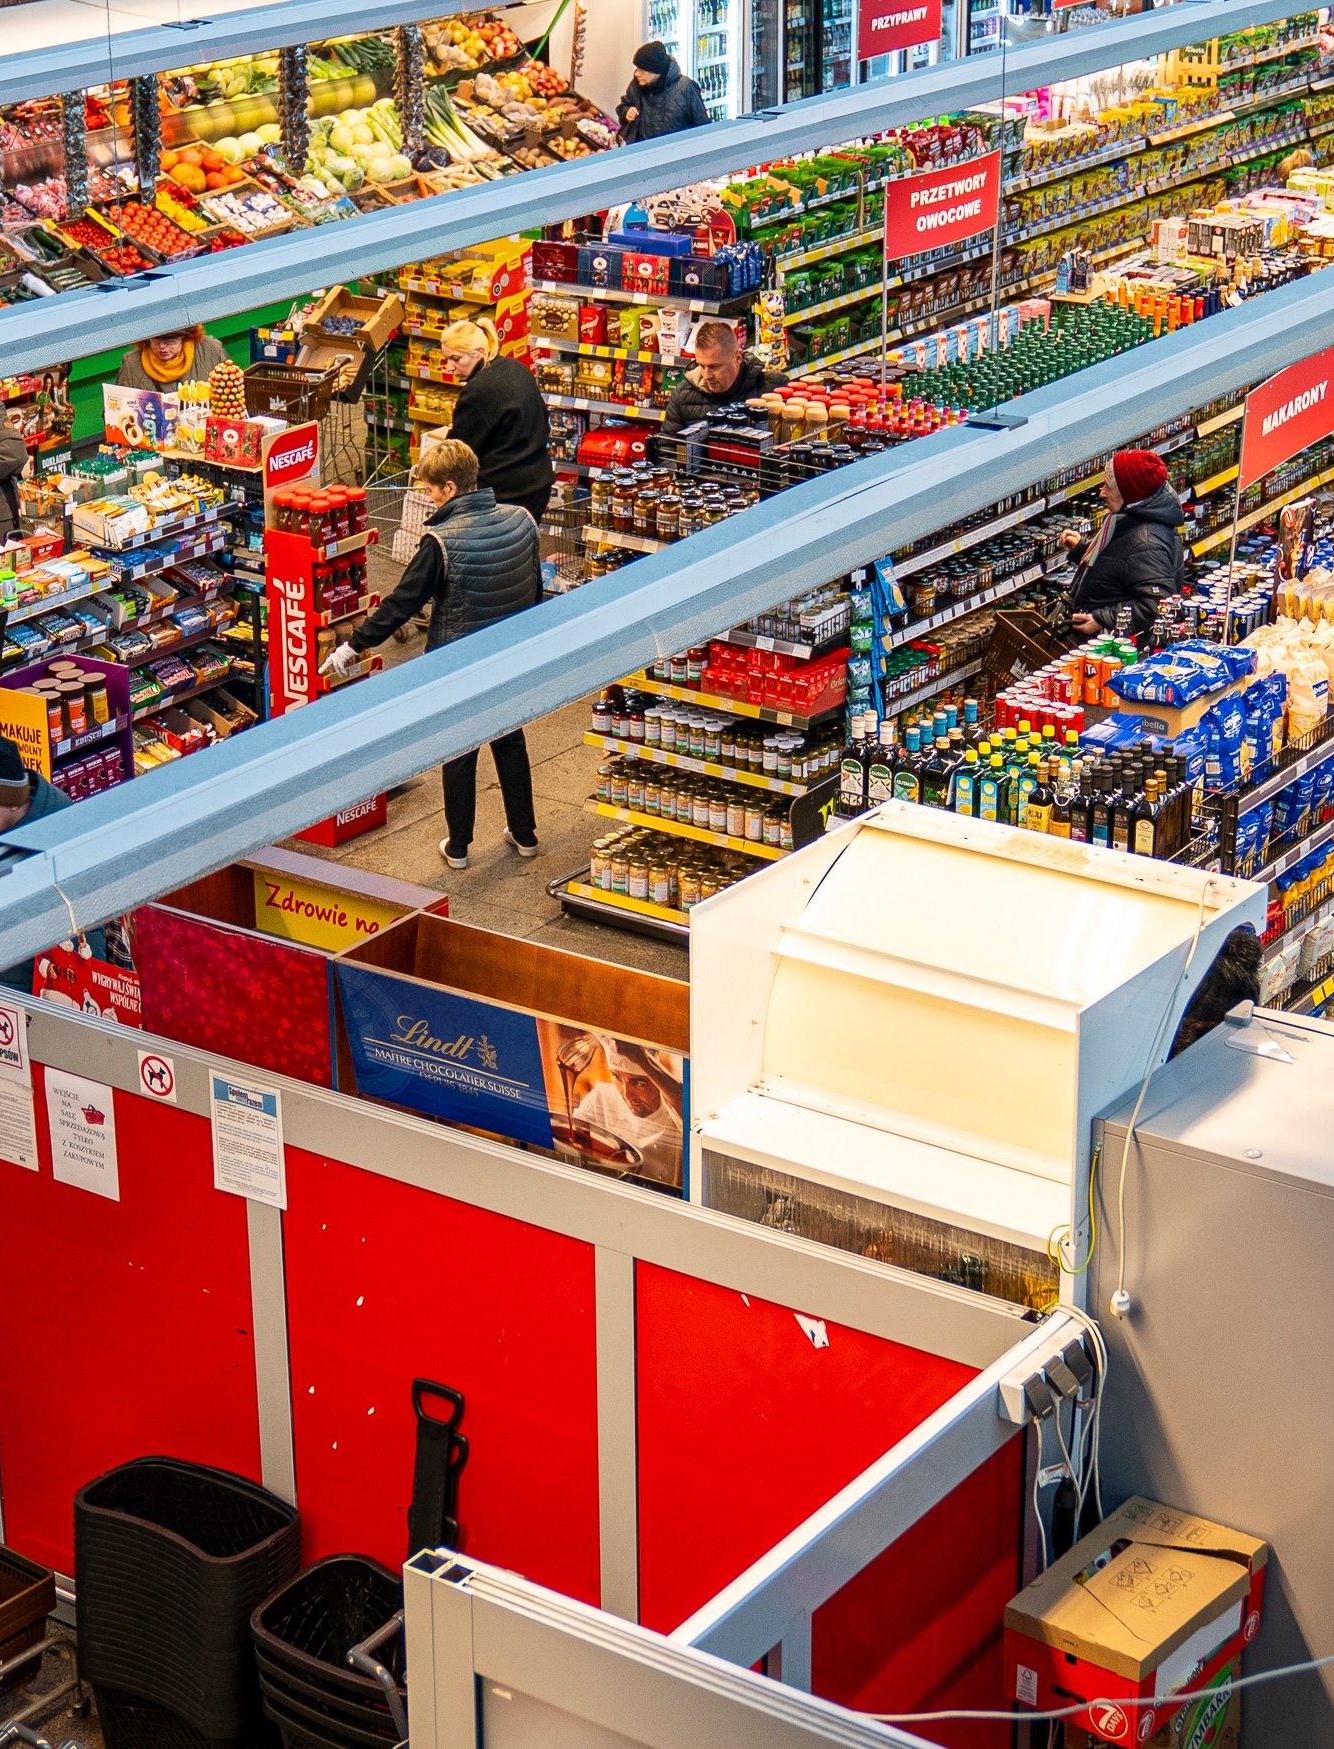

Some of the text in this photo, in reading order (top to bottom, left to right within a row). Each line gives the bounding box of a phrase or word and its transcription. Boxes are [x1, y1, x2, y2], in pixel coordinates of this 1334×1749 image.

[871, 7, 928, 31] PRZYPRAWY
[910, 171, 987, 208] PRZETWORY
[916, 200, 981, 232] OWOCOWE
[1261, 380, 1329, 437] MAKARONY
[269, 440, 315, 473] NESCAFÉ
[273, 577, 309, 714] NESCAFÉ
[336, 795, 378, 827] NESCAFÉ
[264, 882, 380, 935] Zdrowie na
[92, 971, 125, 995] WYGRYWAJ
[109, 991, 138, 1012] WSPÓLNE
[390, 1015, 474, 1060] Lindt
[0, 1046, 19, 1063] PSÓW
[375, 1047, 522, 1099] MAÎTRE CHOCOLATIER SUISSE
[419, 1070, 479, 1098] DEPUIS 1845
[53, 1087, 80, 1101] WEJŚCIE
[62, 1099, 72, 1109] NA
[61, 1110, 77, 1121] SALĘ
[59, 1118, 105, 1140] SPRZEDAŻOWĄ
[73, 1133, 94, 1145] TYLKO
[63, 1150, 105, 1170] ZAKUPOWYM
[69, 1141, 105, 1160] KOSZYKIEM
[1106, 1710, 1124, 1733] DAYS
